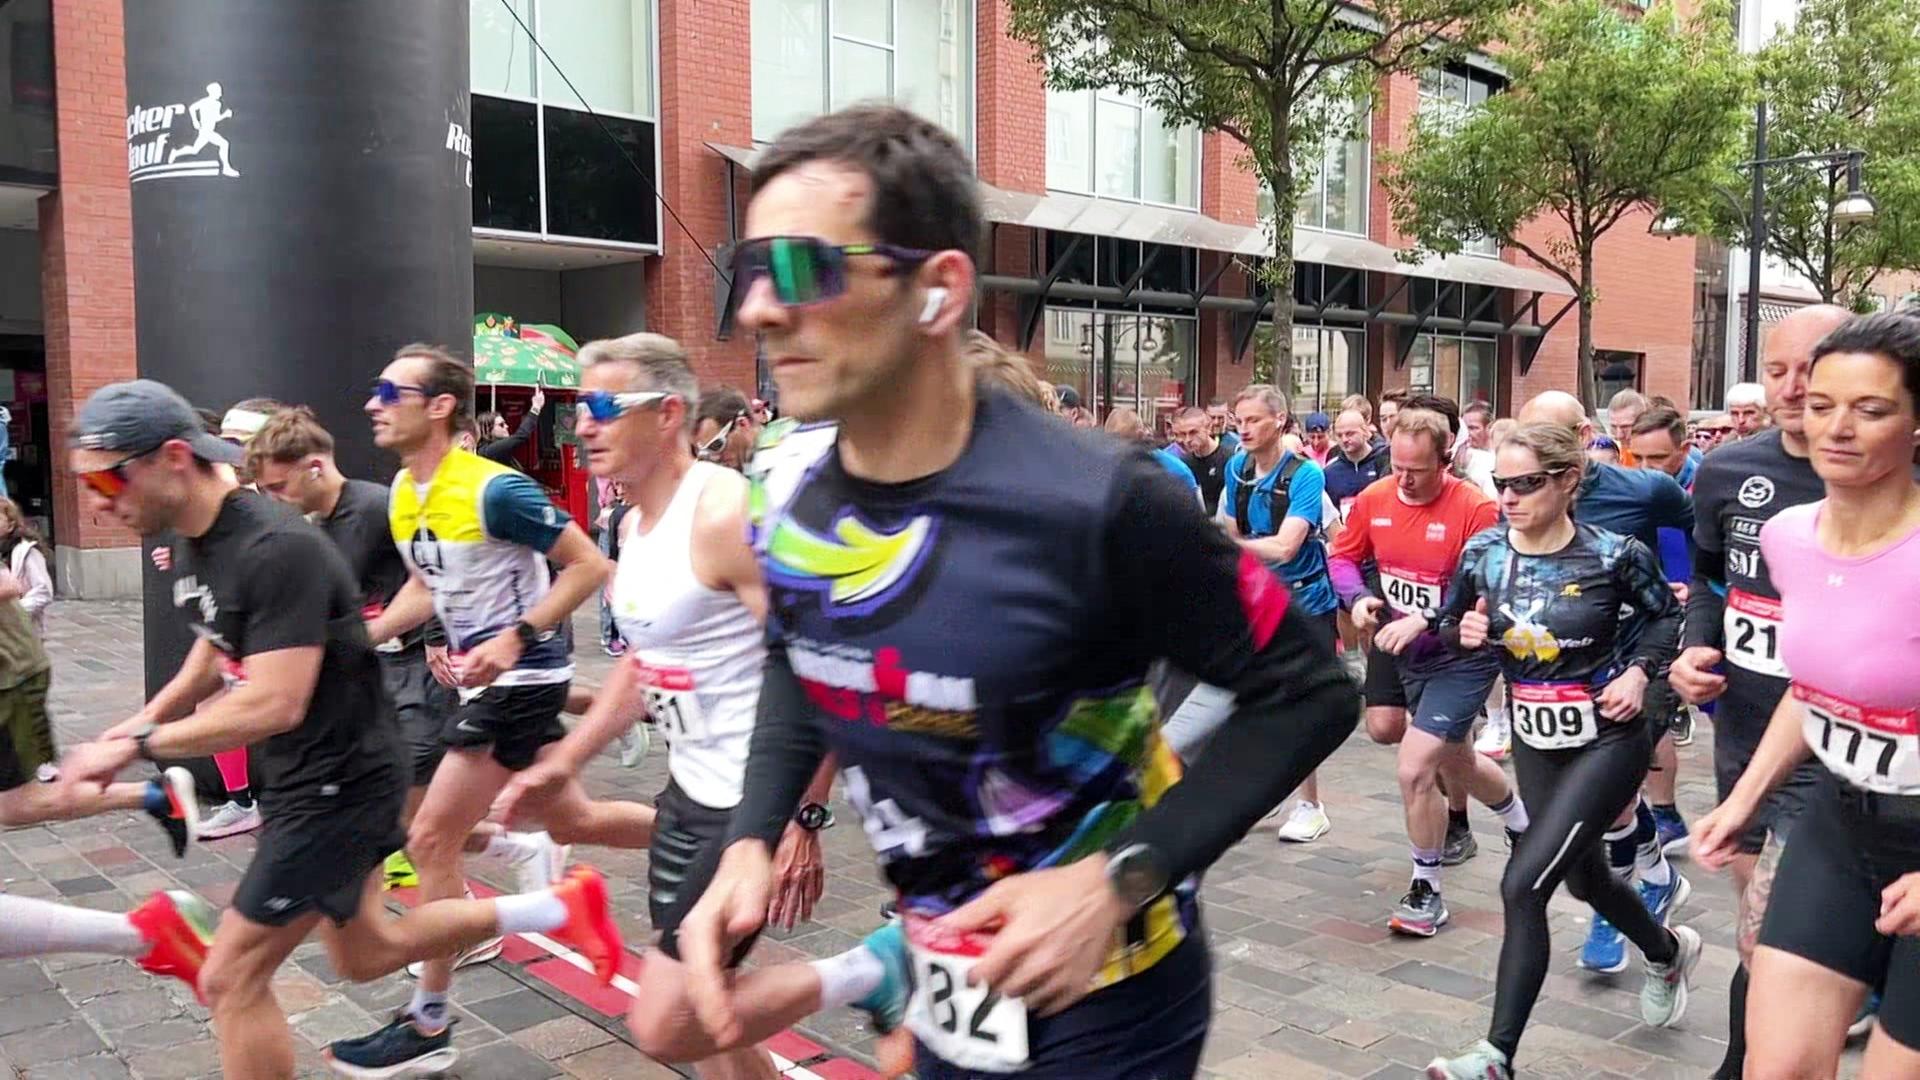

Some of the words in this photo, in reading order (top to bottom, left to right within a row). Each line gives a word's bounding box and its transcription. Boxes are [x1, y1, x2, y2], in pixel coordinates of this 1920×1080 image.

[1388, 578, 1431, 610] 405
[1734, 616, 1777, 660] 21
[1517, 704, 1583, 738] 309
[1809, 708, 1898, 777] 777
